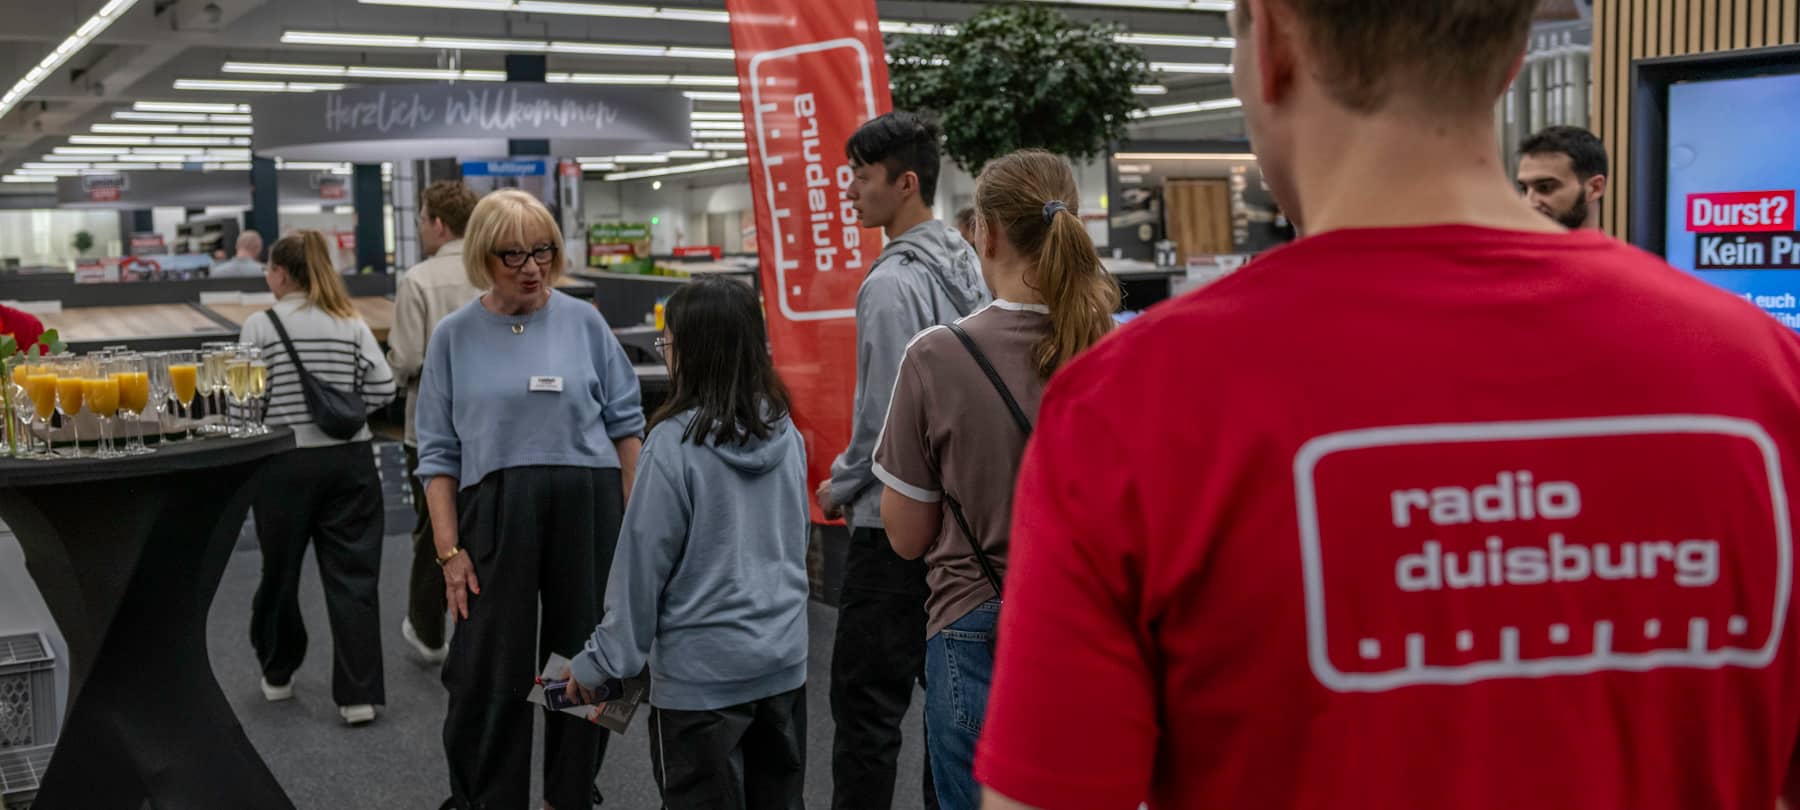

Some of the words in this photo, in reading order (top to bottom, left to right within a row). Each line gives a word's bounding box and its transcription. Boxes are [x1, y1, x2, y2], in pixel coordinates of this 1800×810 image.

[325, 91, 433, 132] Herzlich
[445, 88, 618, 131] Willkommen
[1692, 196, 1788, 226] Durst?
[1700, 236, 1764, 266] Kein
[1391, 469, 1582, 527] radio
[1395, 532, 1720, 591] duisburg
